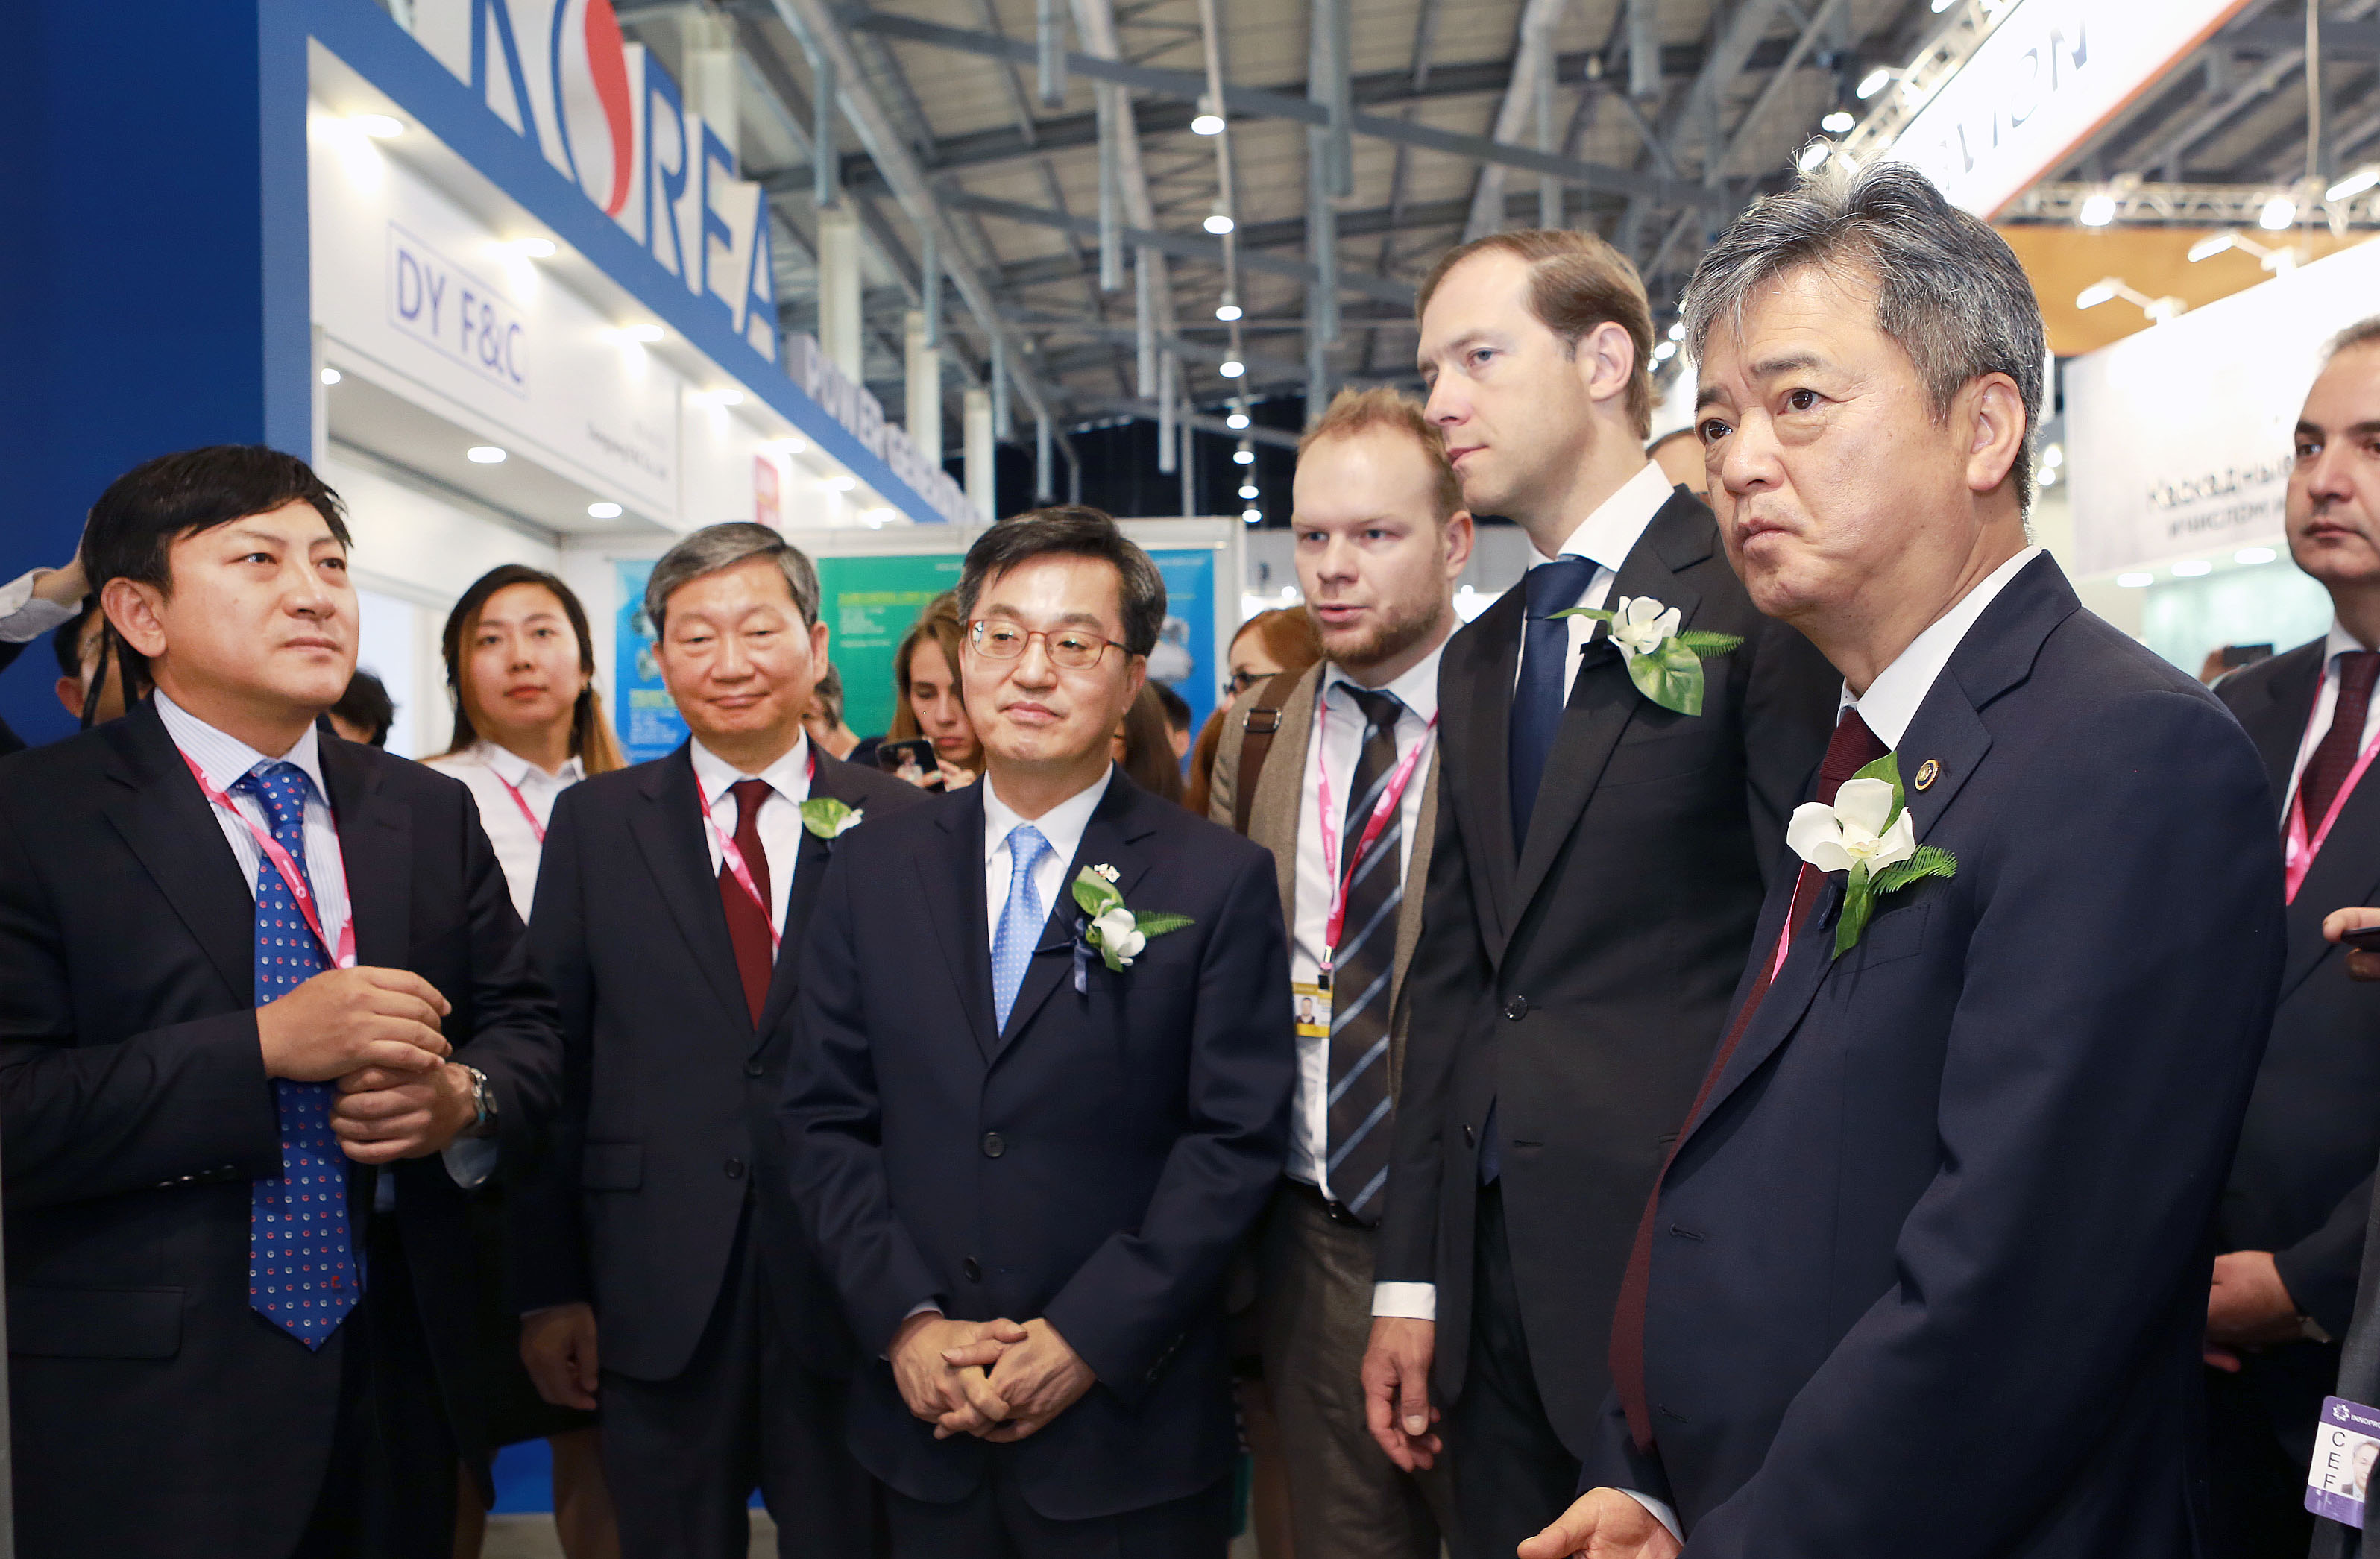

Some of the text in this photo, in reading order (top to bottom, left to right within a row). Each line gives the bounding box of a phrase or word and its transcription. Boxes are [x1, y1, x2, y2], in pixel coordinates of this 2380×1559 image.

[471, 0, 781, 371] KOREA
[397, 248, 523, 384] DY F&C
